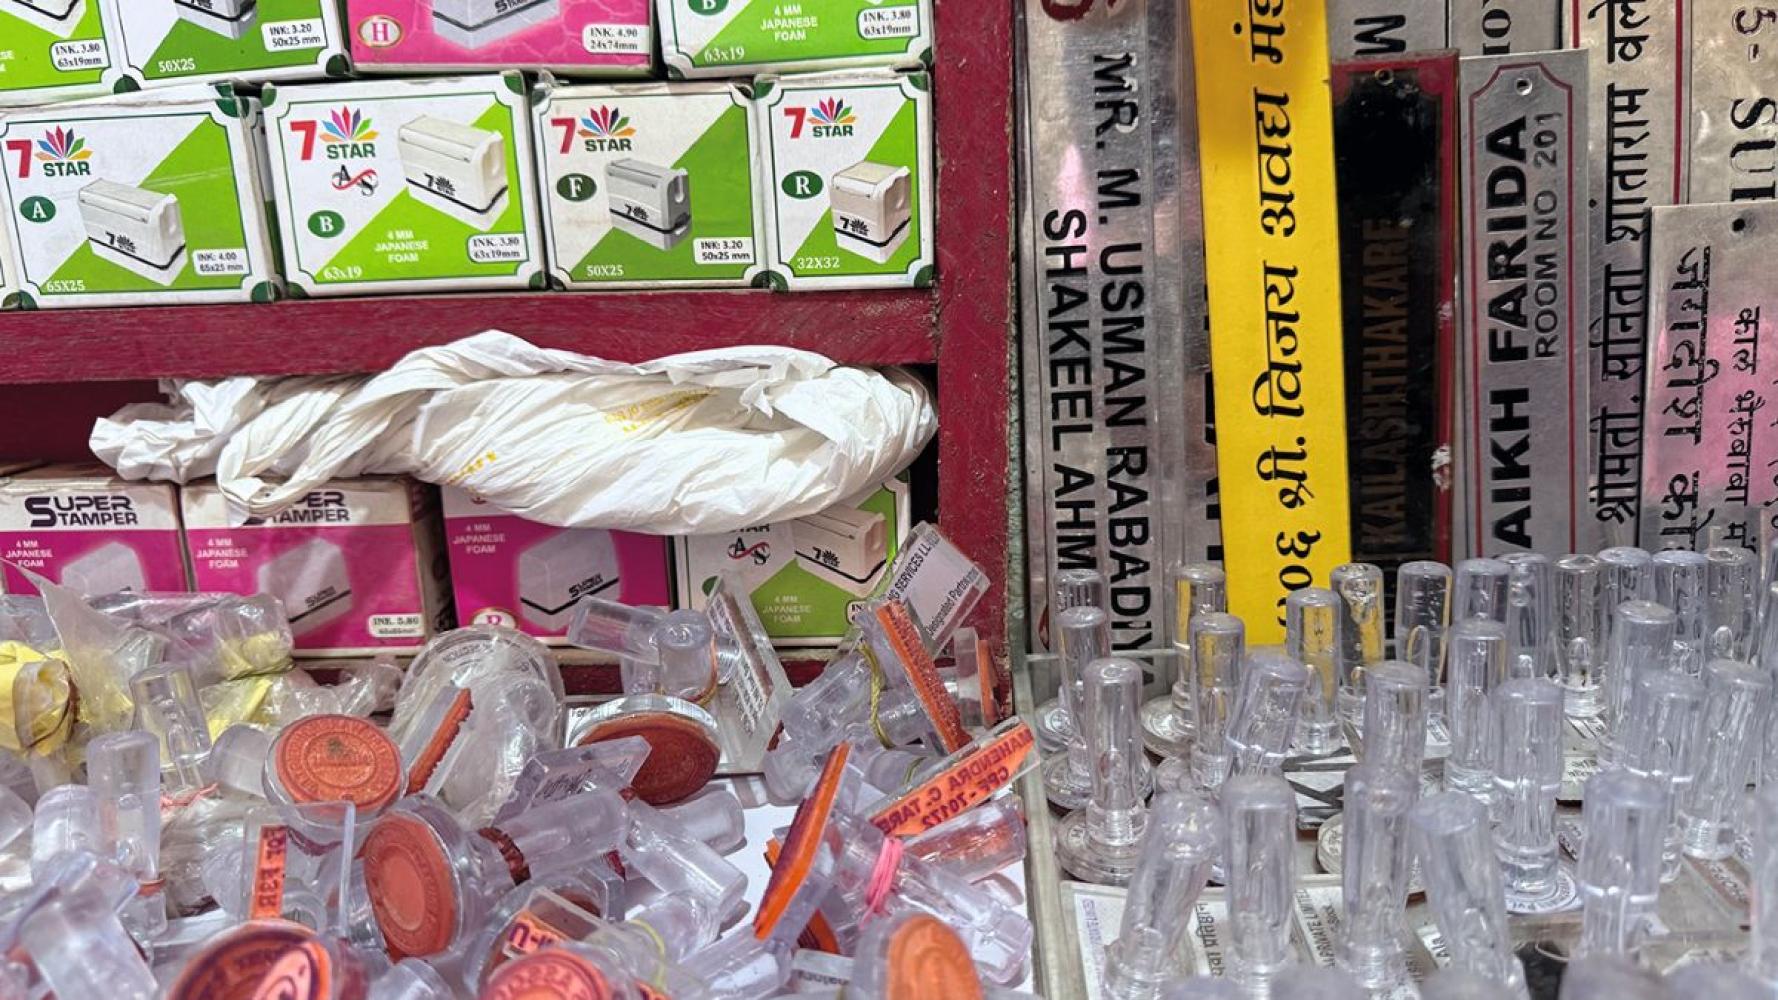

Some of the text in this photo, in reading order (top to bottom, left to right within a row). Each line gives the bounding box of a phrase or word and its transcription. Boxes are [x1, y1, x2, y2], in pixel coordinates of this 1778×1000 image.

[783, 4, 802, 15] MM
[291, 23, 313, 34] 3.20
[760, 16, 818, 31] JAPANESE
[371, 22, 390, 42] H
[774, 30, 807, 41] FOAM
[703, 46, 745, 62] 63x19
[783, 107, 854, 140] 7 STAR
[290, 120, 377, 161] 7 STAR
[550, 118, 633, 155] 7 STAR
[6, 139, 92, 179] 7 STAR
[569, 177, 584, 199] F
[796, 176, 810, 194] R
[31, 201, 47, 219] A
[319, 216, 334, 232] B
[394, 229, 414, 240] MM
[1533, 112, 1563, 358] ROOM NO 201
[374, 240, 430, 252] JAPANESE
[722, 240, 744, 250] 3.20
[387, 252, 420, 264] FOAM
[702, 251, 751, 262] 50x25 mm
[797, 256, 841, 270] 32X32
[323, 264, 363, 281] 63x19
[586, 264, 625, 277] 50X25
[46, 279, 86, 292] 65X25
[1252, 260, 1305, 419] विजय
[1485, 115, 1532, 550] AIKH FARIDA
[1731, 306, 1762, 375] काल
[1093, 52, 1154, 651] MR. M. USMAN RABADIY
[1042, 208, 1098, 571] SHAKEEL AHM
[25, 495, 133, 528] SUPER
[474, 523, 491, 532] MM
[23, 540, 38, 548] MM
[215, 538, 233, 547] MM
[452, 533, 506, 545] JAPANESE
[6, 549, 53, 558] JAPANESE
[197, 548, 248, 558] JAPANESE
[466, 544, 497, 554] FOAM
[209, 560, 239, 569] FOAM
[898, 552, 925, 594] SERVICES
[762, 604, 813, 614] JAPANESE
